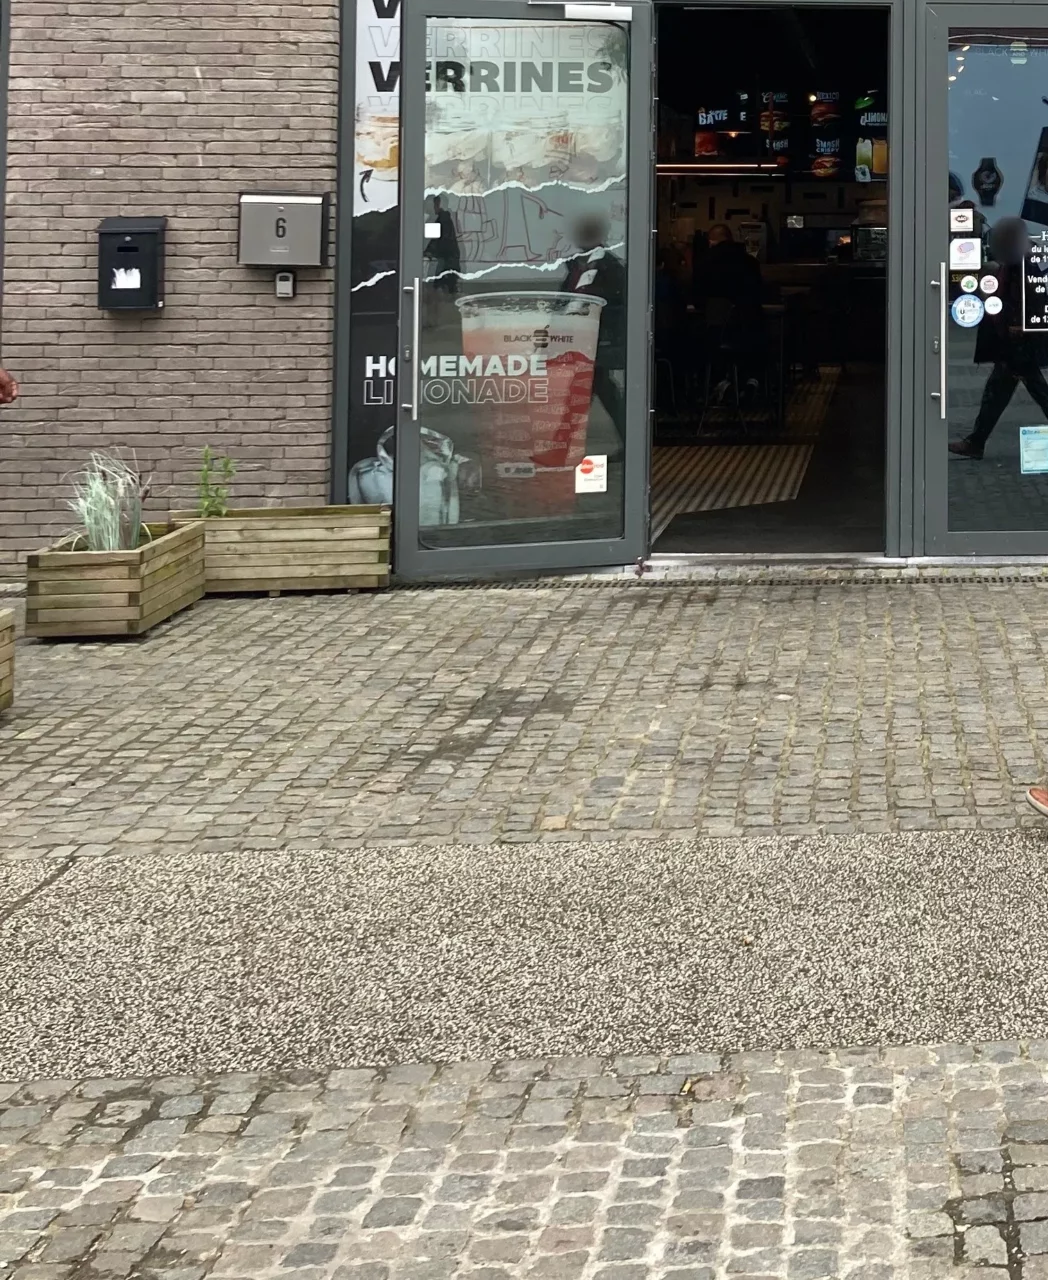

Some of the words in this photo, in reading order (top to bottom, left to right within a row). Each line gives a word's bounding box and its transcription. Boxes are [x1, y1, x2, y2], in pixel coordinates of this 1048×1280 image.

[368, 25, 613, 59] VRRINES
[368, 61, 614, 93] VRRINES
[274, 217, 286, 239] 6
[1031, 245, 1042, 253] du
[1030, 255, 1041, 263] de
[1035, 285, 1046, 293] de
[1030, 315, 1041, 323] de
[503, 334, 532, 342] BLACK
[550, 335, 574, 343] WHITE
[365, 354, 548, 378] HMEMADE
[363, 378, 549, 405] LIONADE
